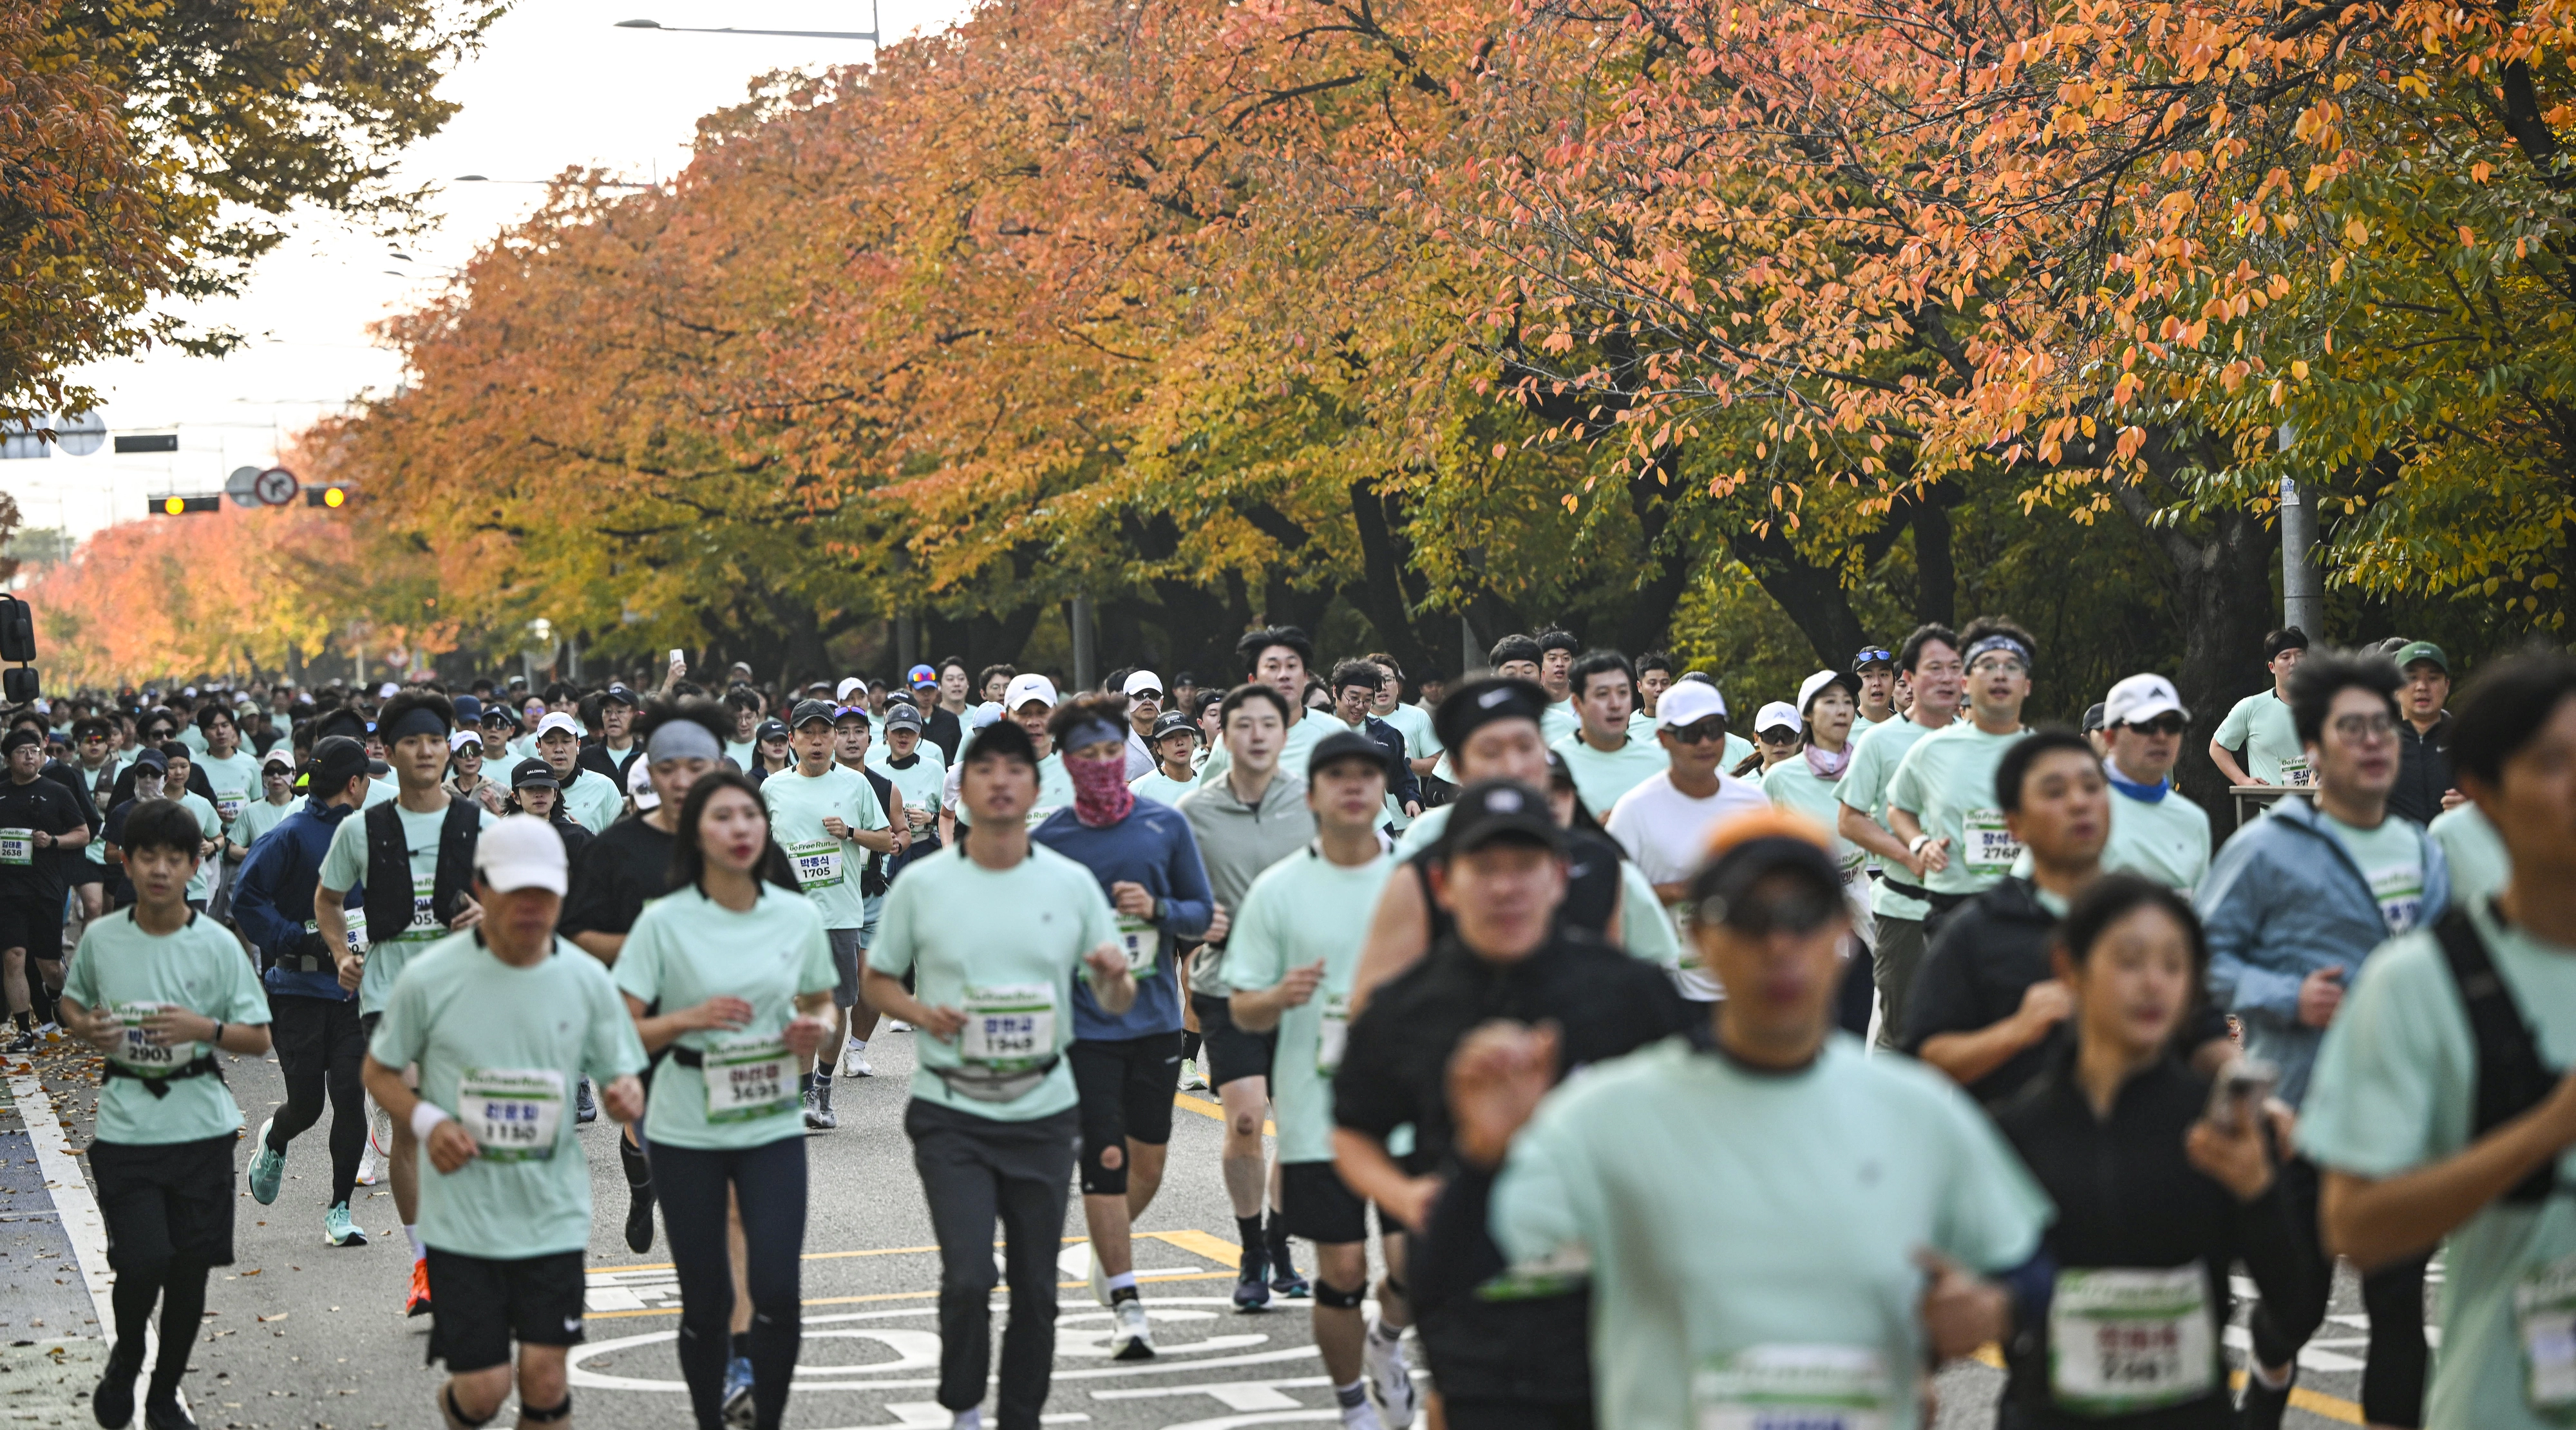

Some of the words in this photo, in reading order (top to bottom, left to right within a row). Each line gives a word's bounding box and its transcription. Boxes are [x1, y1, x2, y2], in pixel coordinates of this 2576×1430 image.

[2293, 769, 2311, 780] 조시
[2, 841, 22, 849] 김태훈
[800, 856, 829, 867] 박종식
[802, 867, 831, 878] 1705
[129, 1046, 173, 1062] 2903
